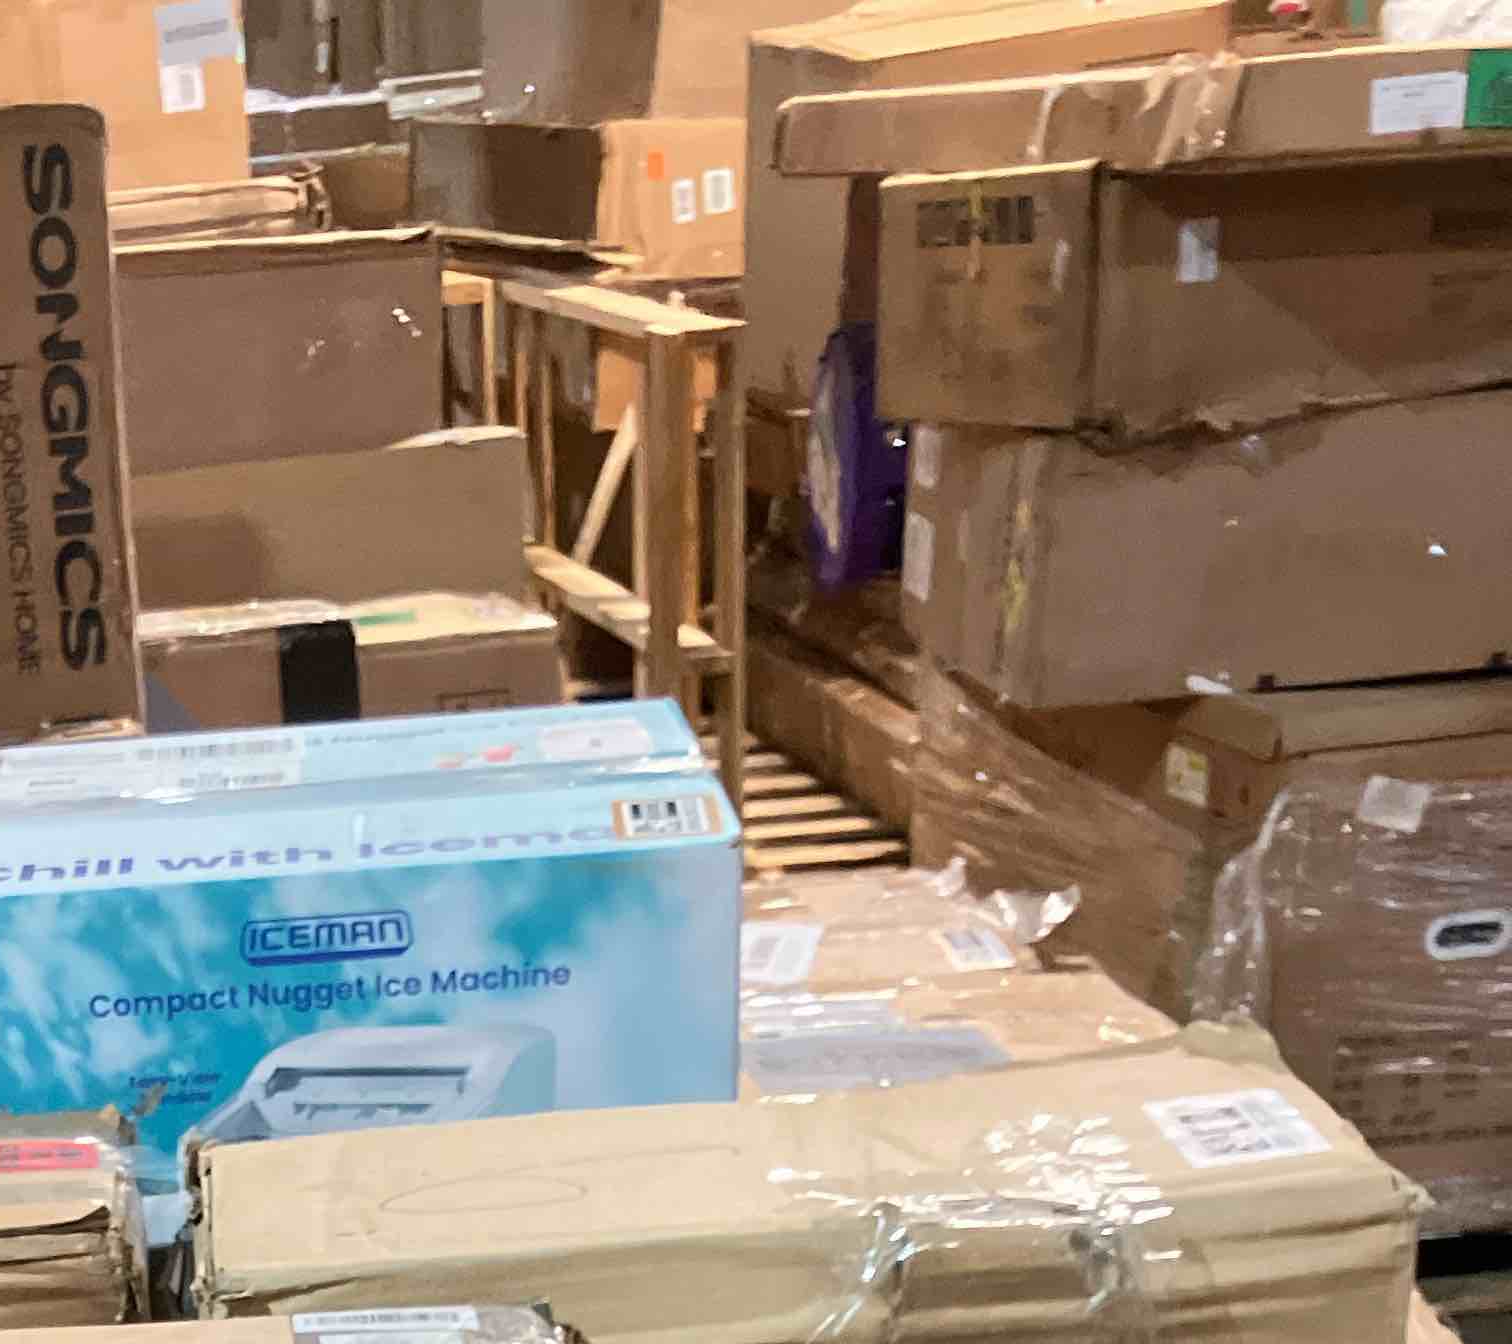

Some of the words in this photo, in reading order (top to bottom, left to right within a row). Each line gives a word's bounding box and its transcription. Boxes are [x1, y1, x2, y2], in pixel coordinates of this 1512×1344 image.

[23, 143, 107, 671] SONGMICS
[15, 590, 42, 673] HOME
[158, 844, 336, 872] with
[358, 825, 614, 860] Icema
[246, 919, 405, 953] ICEMAN
[89, 983, 239, 1021] Compact
[248, 974, 367, 1010] Nugget
[374, 972, 422, 999] Ice
[431, 962, 572, 993] Machine
